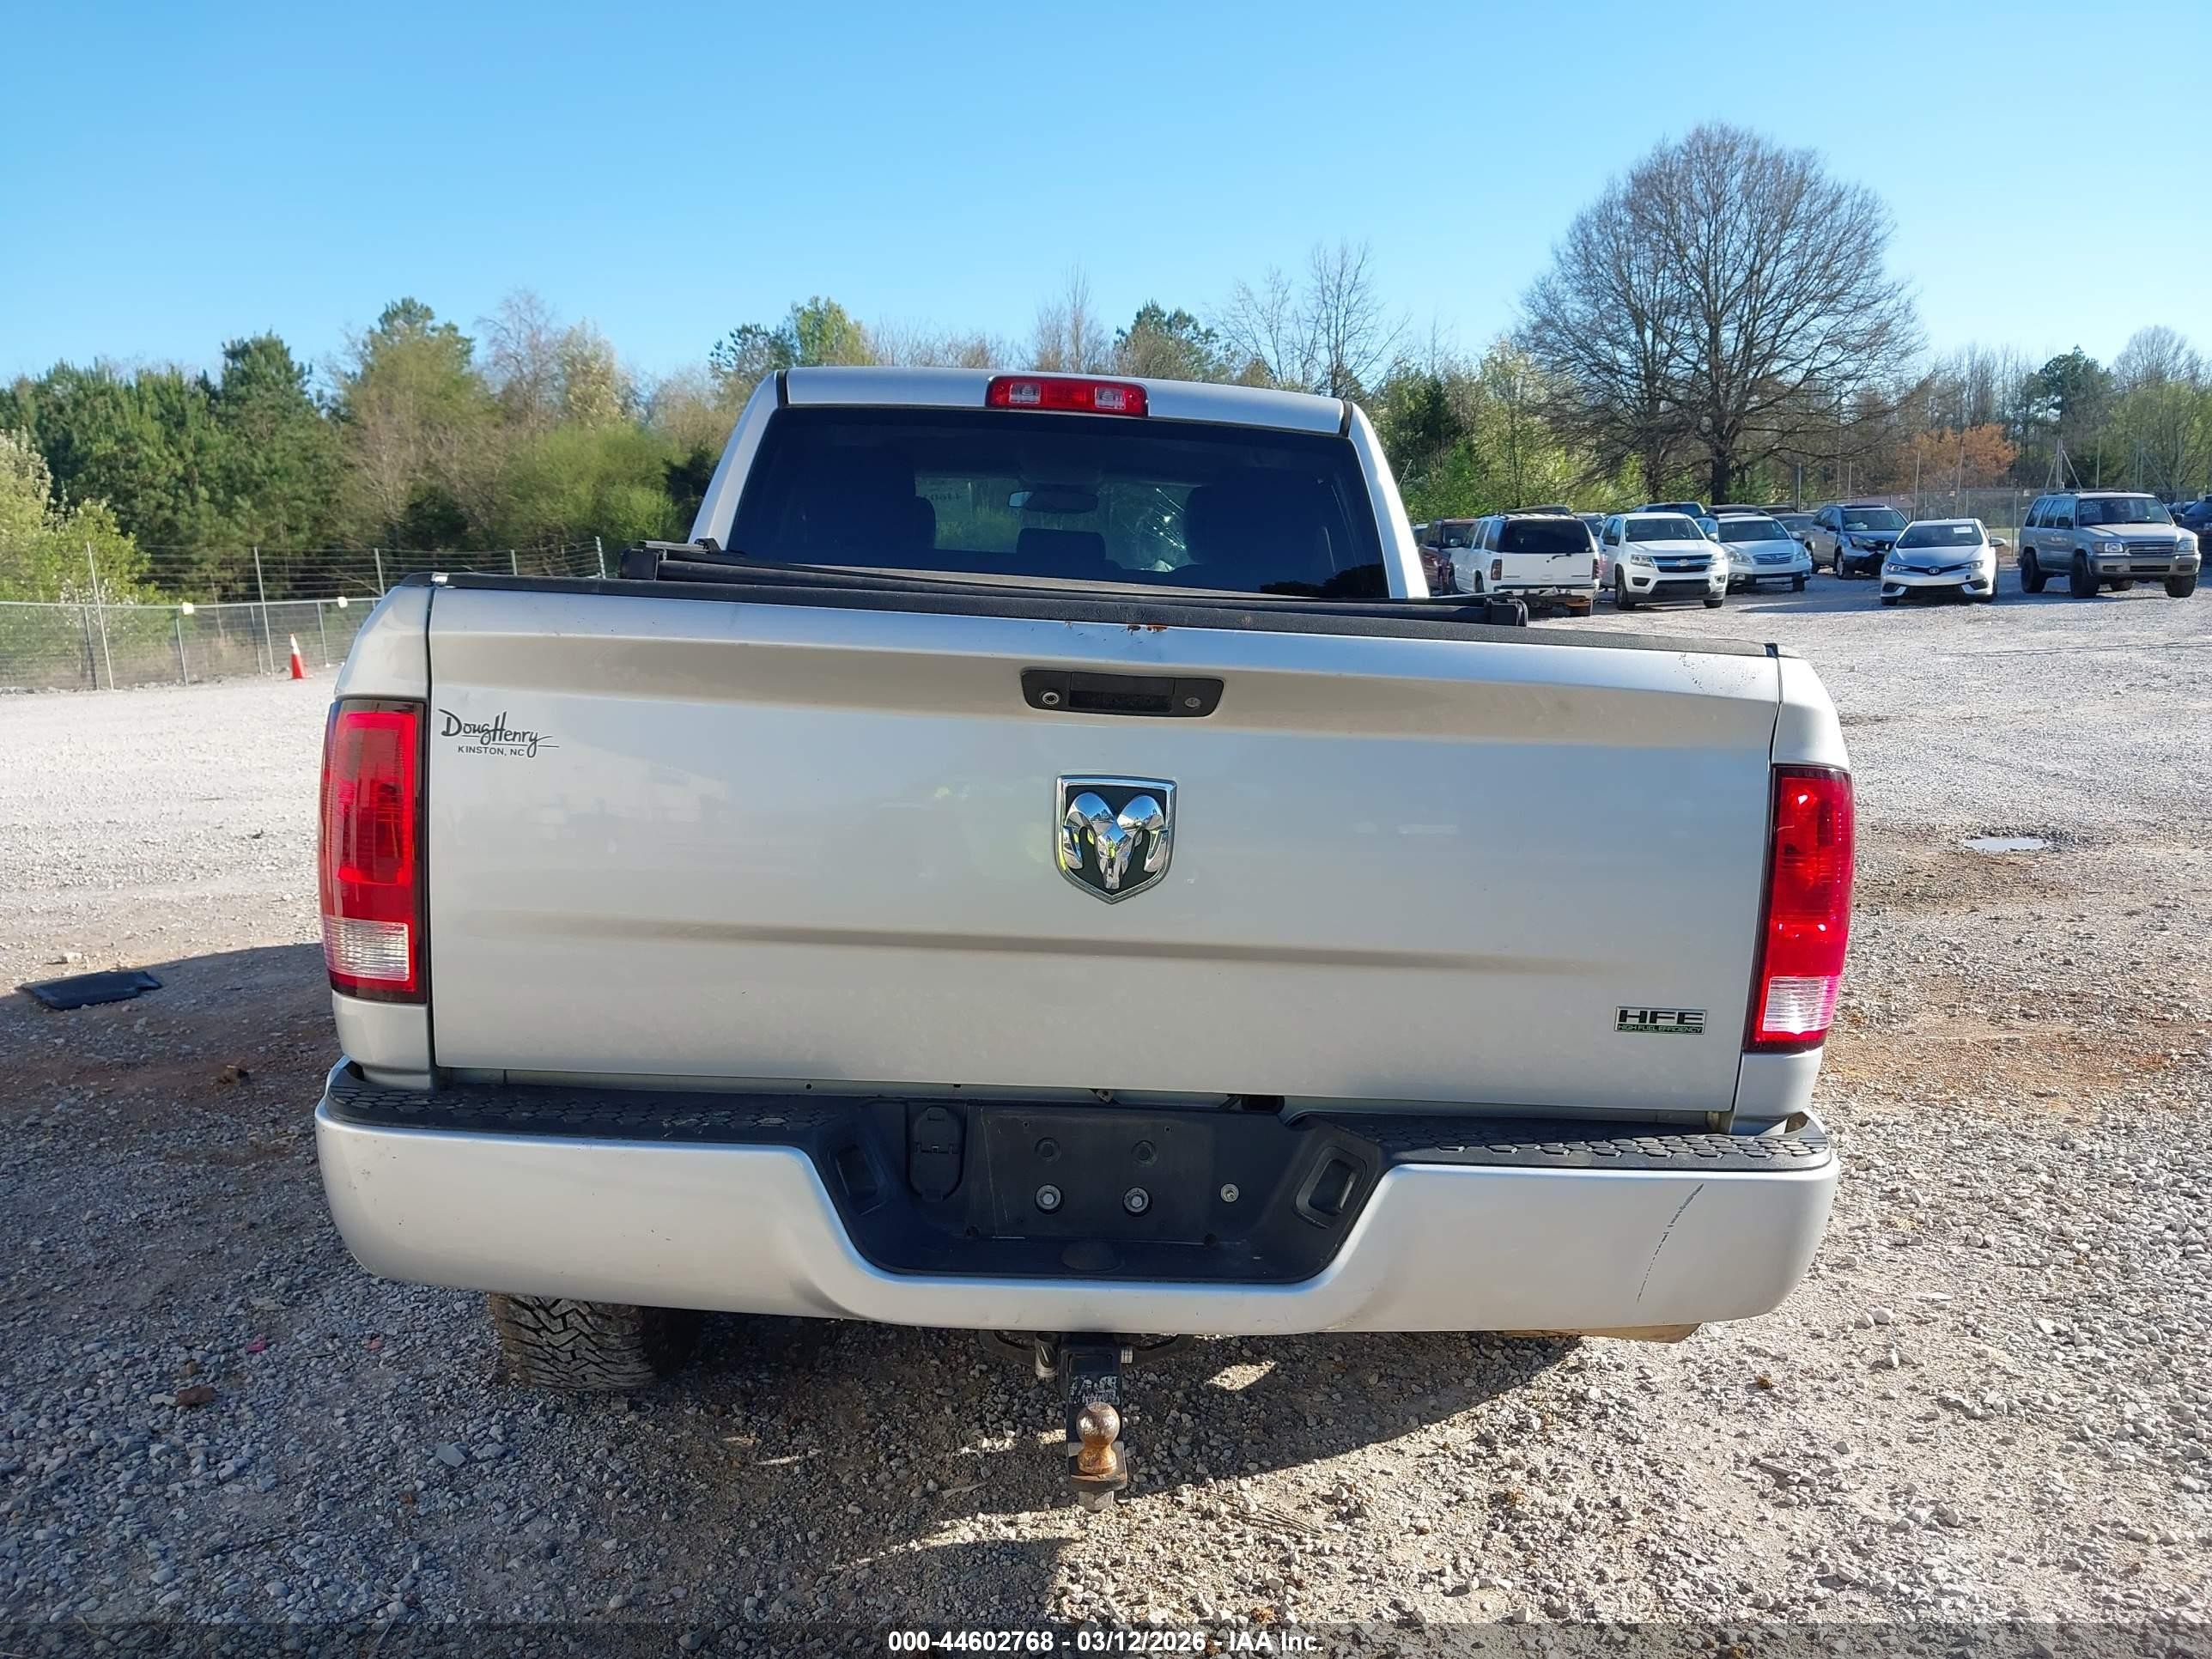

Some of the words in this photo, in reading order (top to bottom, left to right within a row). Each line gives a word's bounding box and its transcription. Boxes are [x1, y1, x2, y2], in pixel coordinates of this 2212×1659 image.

[458, 745, 507, 757] KINSTON,
[510, 748, 525, 757] NC
[1619, 1009, 1704, 1025] HFE
